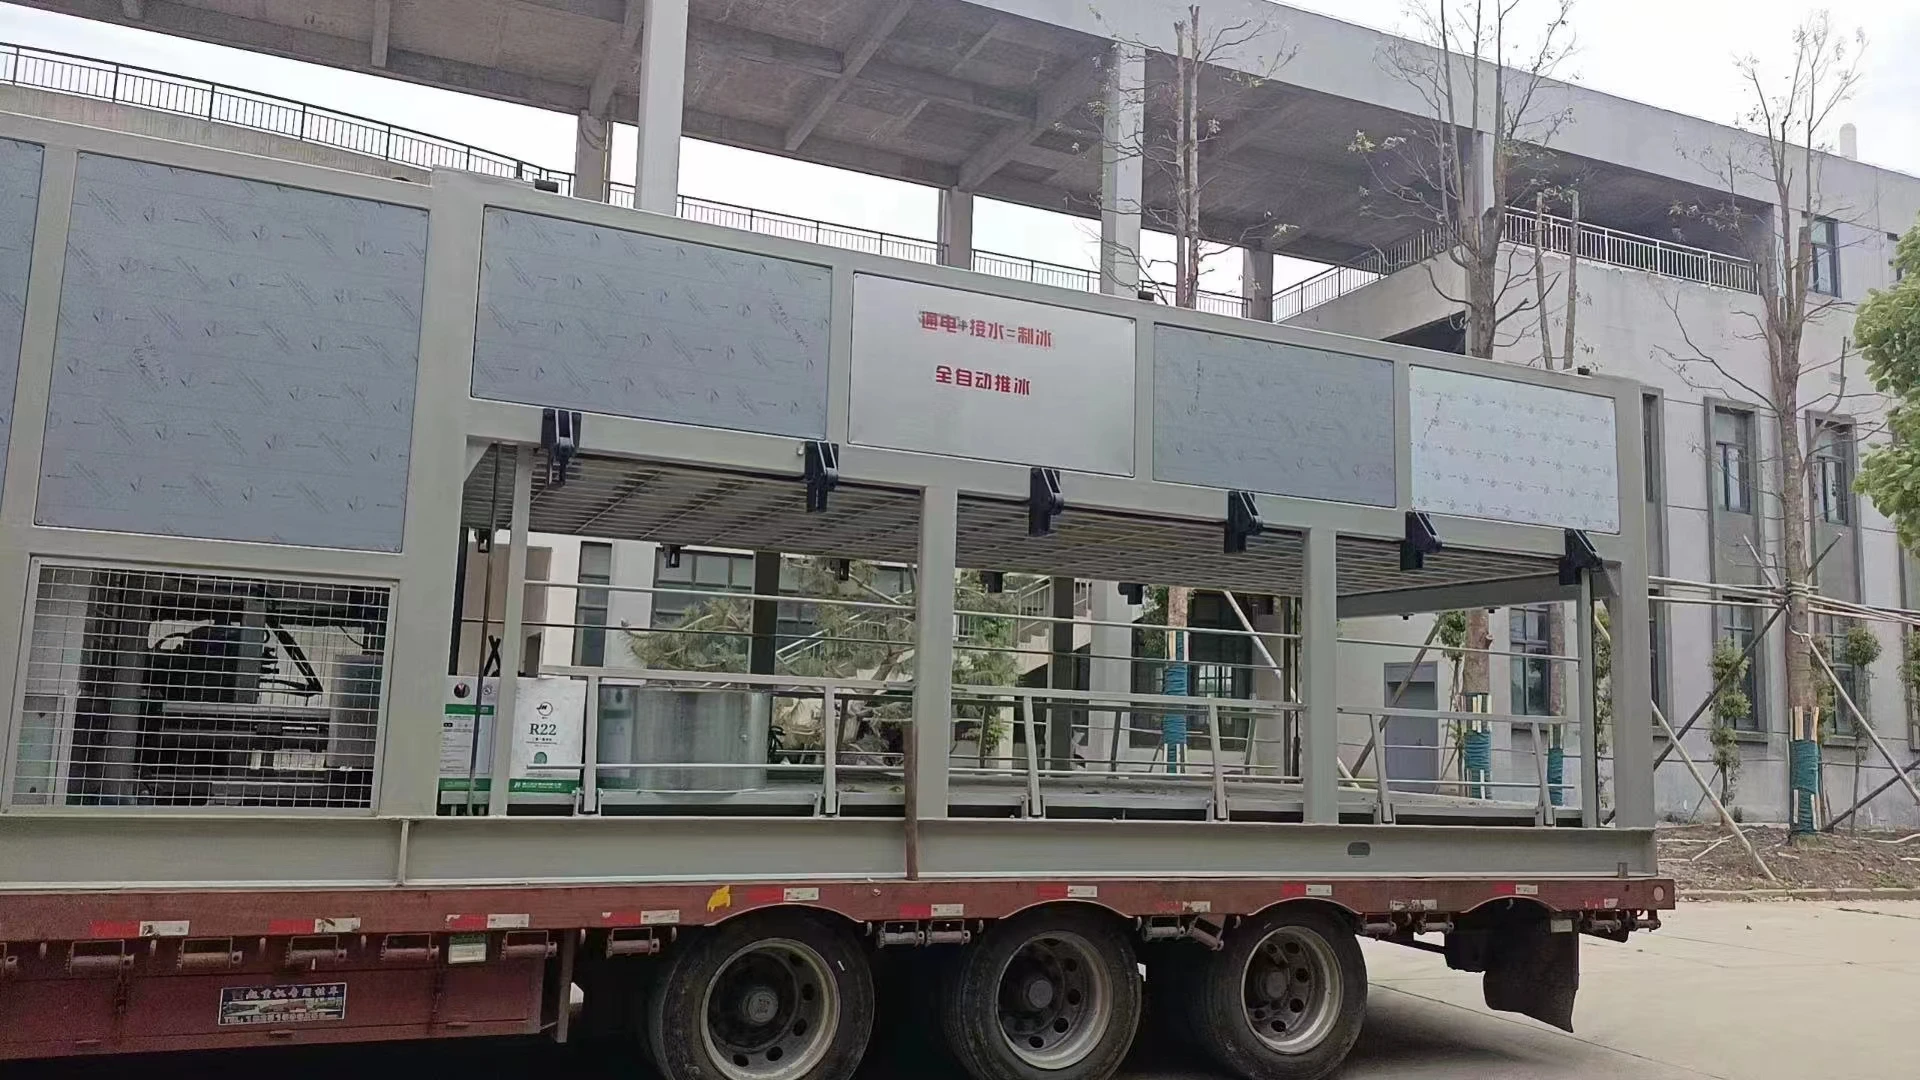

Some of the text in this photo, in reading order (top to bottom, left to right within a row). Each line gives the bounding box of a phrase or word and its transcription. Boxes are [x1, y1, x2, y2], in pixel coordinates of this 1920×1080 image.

[936, 365, 1031, 395] 全自动推冰
[529, 723, 557, 736] R22
